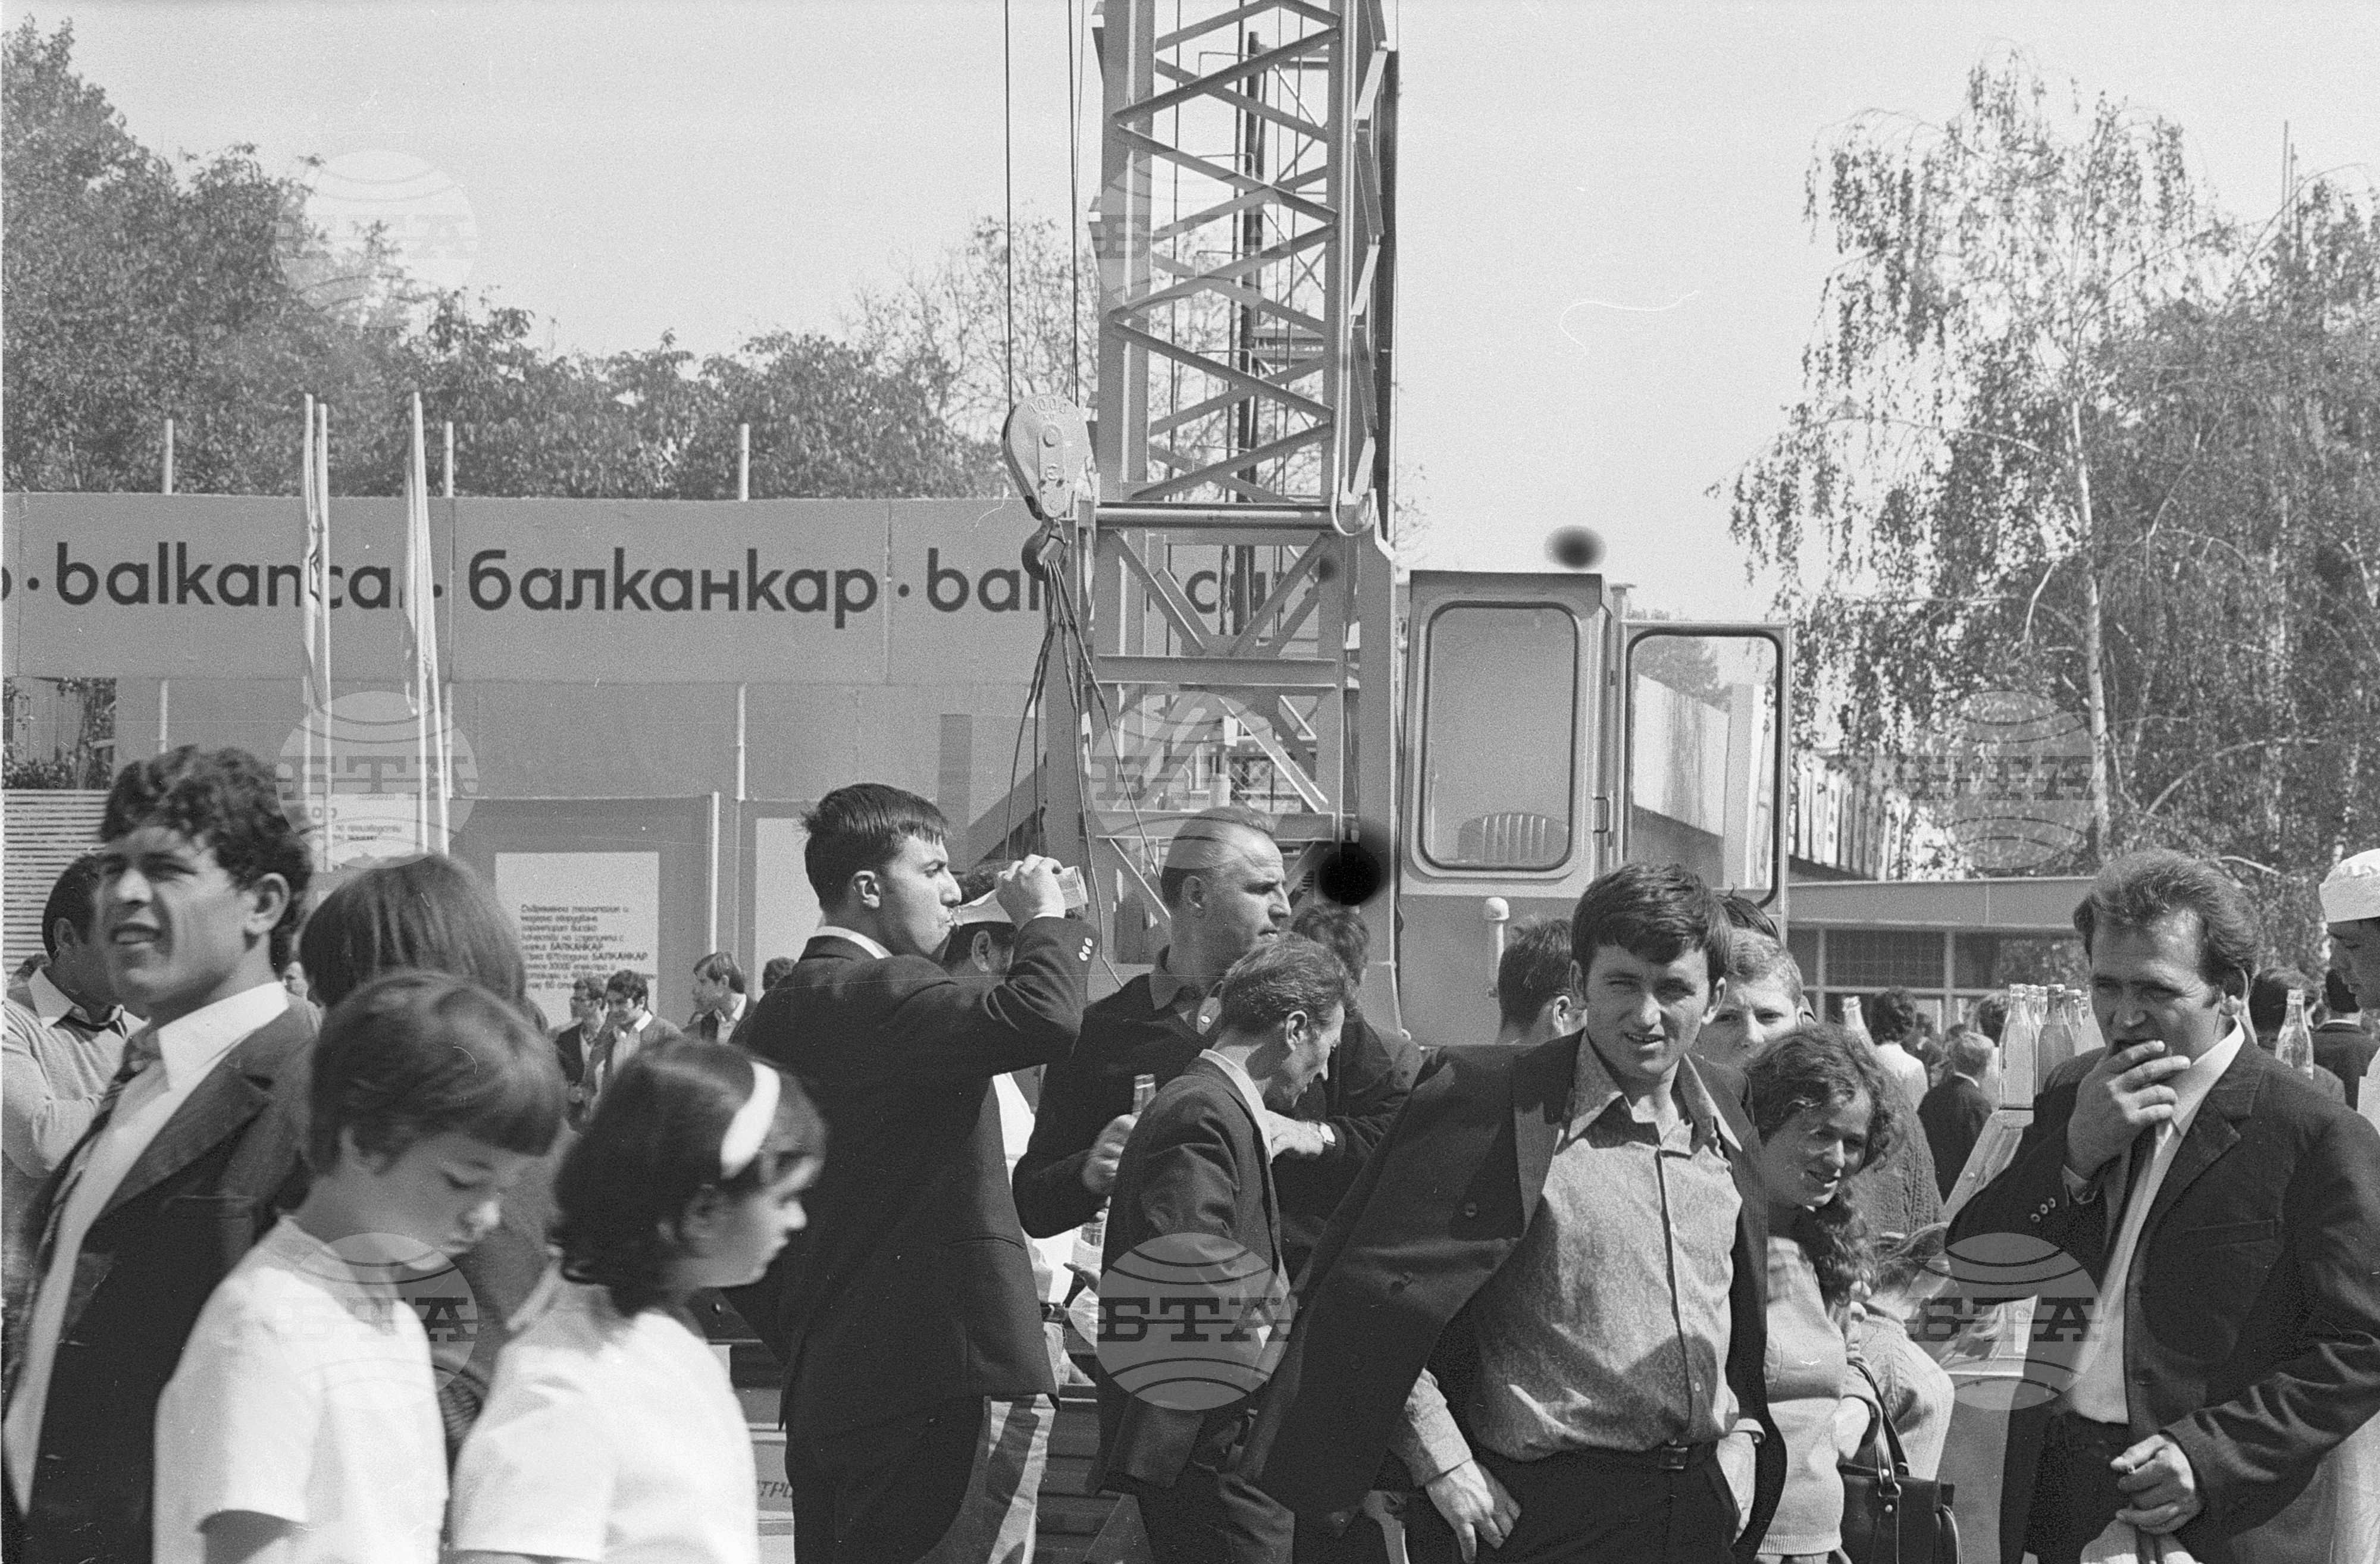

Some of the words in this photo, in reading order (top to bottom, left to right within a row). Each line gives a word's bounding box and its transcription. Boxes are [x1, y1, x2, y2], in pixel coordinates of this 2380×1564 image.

[57, 541, 403, 609] balkana
[550, 942, 604, 951] БАЛКАНКАР
[593, 952, 648, 960] БАЛКАНКАР
